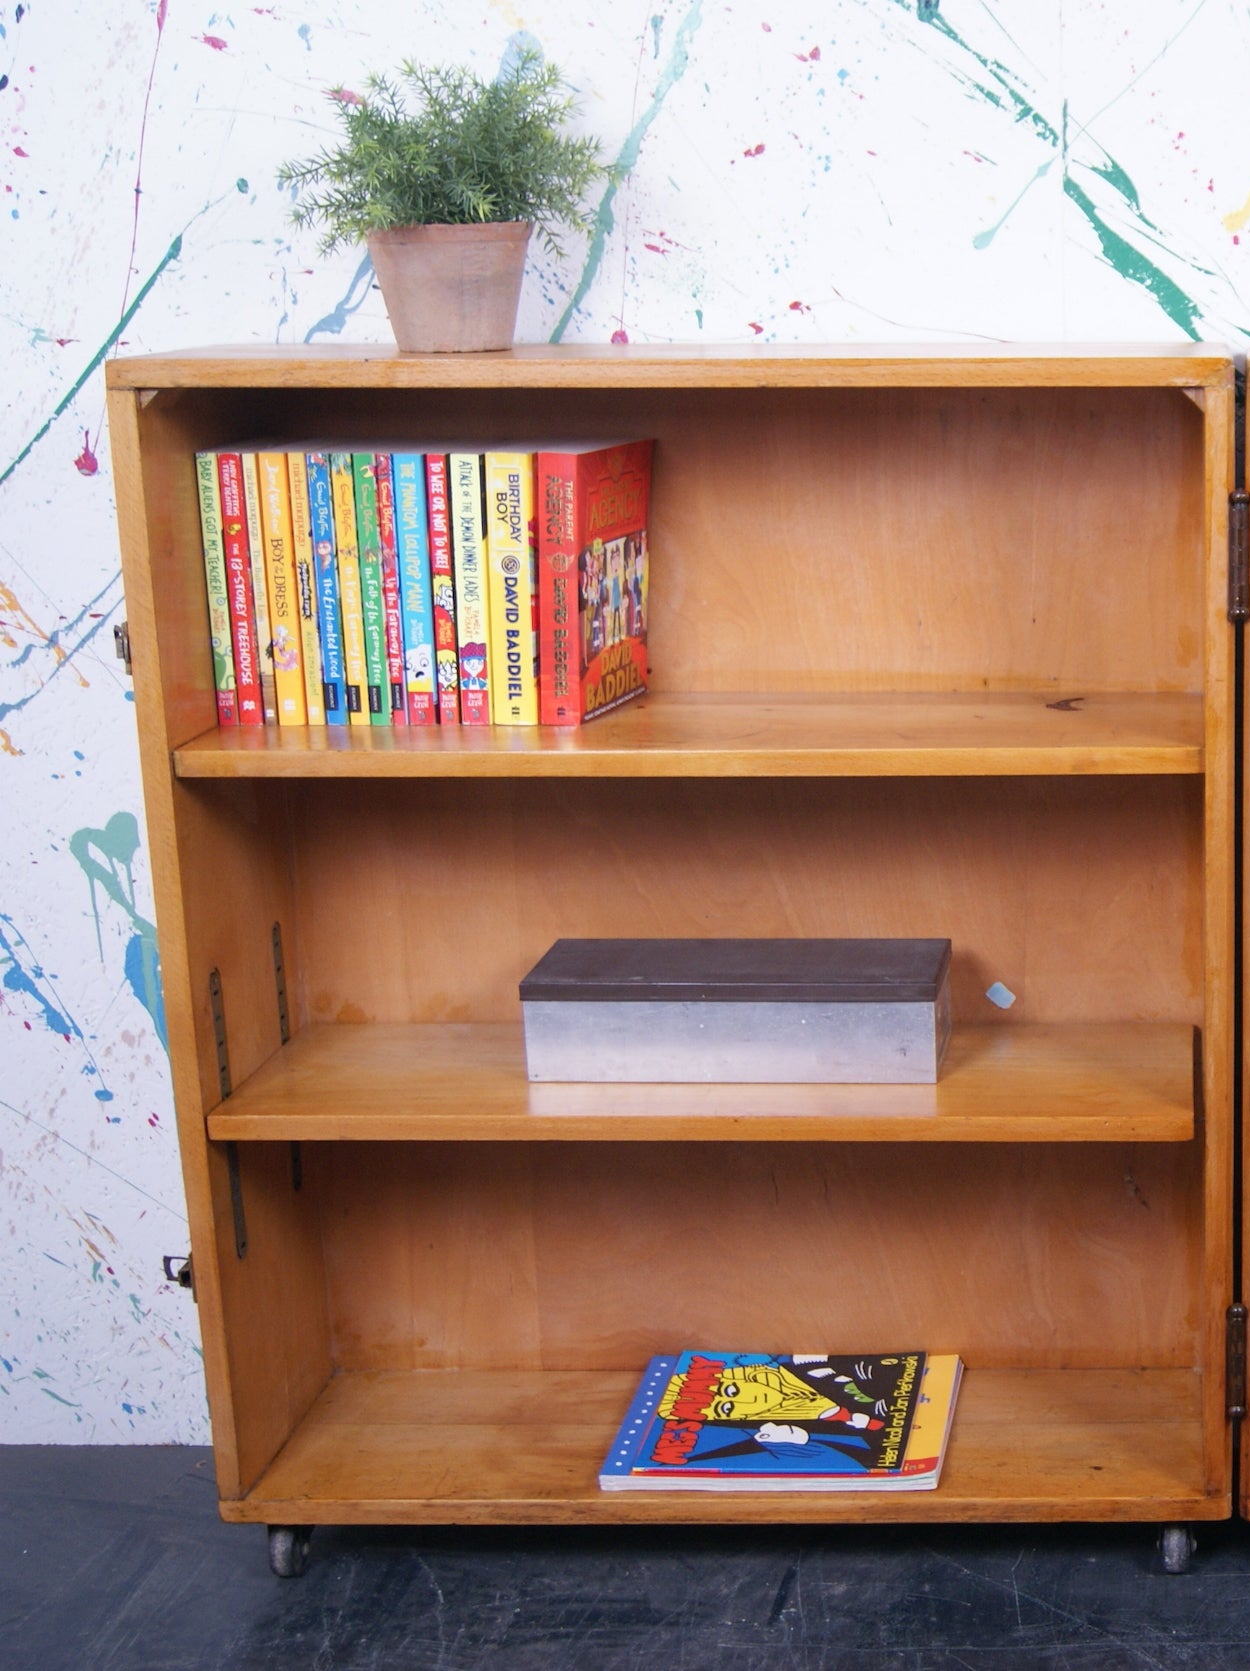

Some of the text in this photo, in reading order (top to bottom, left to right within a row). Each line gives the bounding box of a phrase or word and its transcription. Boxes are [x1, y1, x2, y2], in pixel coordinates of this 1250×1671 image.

[199, 461, 212, 482] BABY
[431, 474, 445, 494] WEE
[201, 484, 215, 513] ALIENS
[315, 481, 328, 536] Enid Blyton
[432, 497, 446, 512] OR
[496, 492, 509, 525] BOY
[508, 474, 522, 544] BIRTHDAY
[545, 474, 564, 545] AGENCY
[565, 481, 574, 542] THE PARENT
[589, 488, 641, 532] AGENCY
[205, 517, 217, 535] GOT
[433, 514, 447, 533] NOT
[460, 516, 475, 544] DEMON
[271, 538, 285, 566] BOY
[462, 545, 478, 573] DINNER
[208, 555, 224, 594] TEACHER!
[231, 558, 247, 617] 13-STOREY
[463, 576, 480, 603] LADIES
[274, 576, 288, 617] DRESS
[323, 596, 338, 649] Enchanted
[387, 609, 400, 655] Faraway
[238, 621, 253, 685] TREEHOUSE
[368, 625, 379, 661] Faraway
[504, 577, 522, 700] DAVID BADDIEL
[329, 651, 340, 678] Wood
[372, 663, 381, 684] Tree
[390, 657, 403, 678] Tree
[601, 644, 632, 676] DAVID
[586, 662, 643, 712] BADDIEL
[670, 1355, 727, 1421] MUMMY
[890, 1397, 910, 1411] Jan
[890, 1412, 906, 1427] and
[882, 1427, 903, 1448] Nicoll
[877, 1446, 899, 1467] Helen
